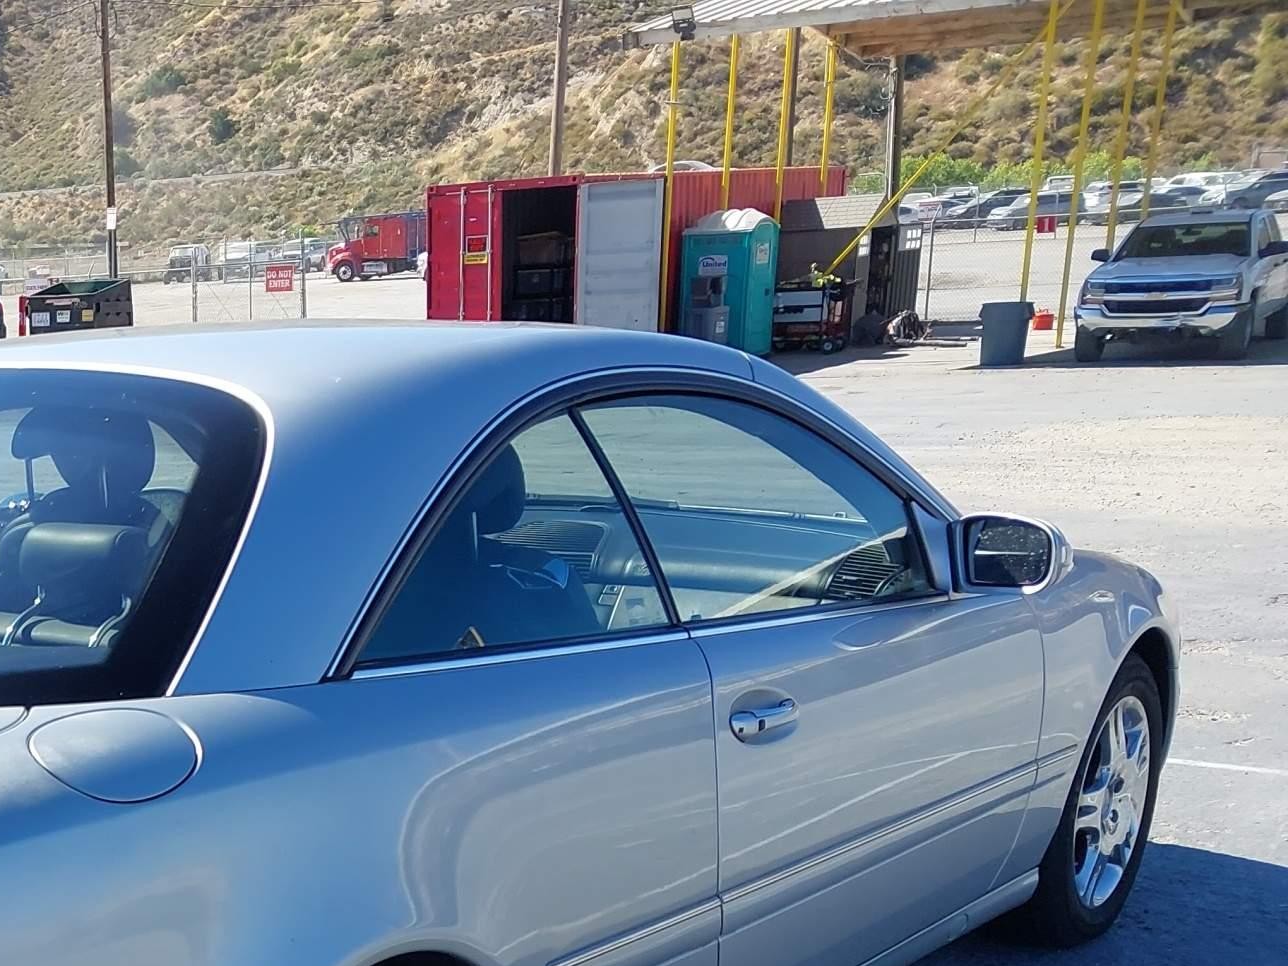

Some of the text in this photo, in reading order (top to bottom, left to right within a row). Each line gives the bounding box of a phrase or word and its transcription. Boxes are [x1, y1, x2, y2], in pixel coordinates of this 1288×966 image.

[702, 260, 727, 268] United
[267, 269, 292, 279] DO NOT
[268, 279, 290, 288] ENTER
